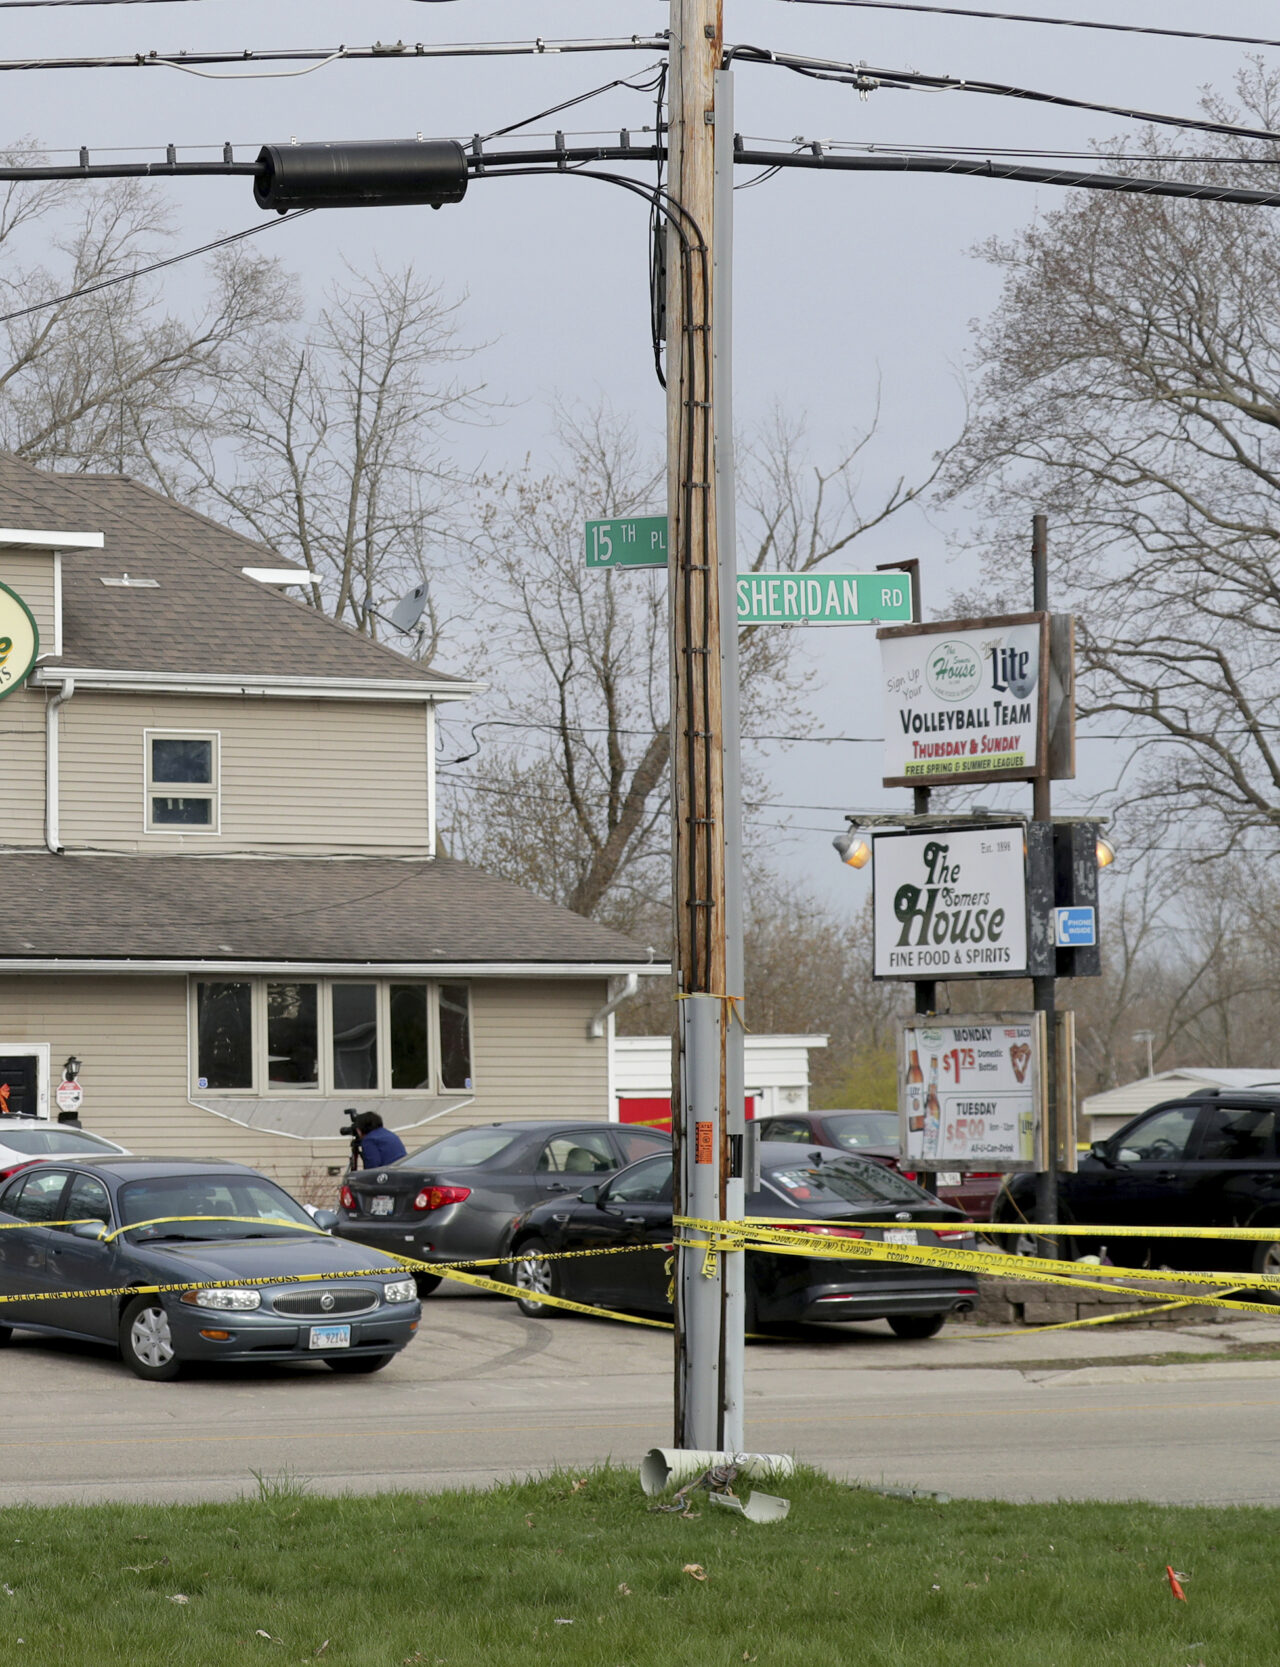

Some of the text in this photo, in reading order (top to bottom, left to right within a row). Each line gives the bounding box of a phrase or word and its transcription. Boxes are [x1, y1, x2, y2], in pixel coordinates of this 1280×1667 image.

[651, 531, 666, 549] PL
[737, 580, 903, 616] SHERIDAN RD
[933, 657, 976, 681] House
[989, 647, 1029, 693] Lite
[887, 676, 906, 693] Sign
[902, 685, 923, 701] Your
[899, 701, 1032, 734] VOLLEYBALL TEAM
[912, 735, 1021, 759] THURSDAY & SUNDAY
[905, 763, 925, 776] FREE
[927, 761, 953, 774] SPRING
[962, 759, 991, 772] SUMMER
[993, 756, 1024, 769] LEAGUES
[923, 841, 961, 885] The
[941, 886, 990, 907] Somers
[894, 883, 1005, 947] House
[1068, 919, 1092, 927] PHONE
[889, 947, 1011, 967] FINE FOOD & SPIRITS
[953, 1028, 992, 1042] MONDAY
[977, 1049, 1004, 1058] Domestic
[979, 1062, 998, 1072] Bottles
[956, 1102, 997, 1116] TUESDAY
